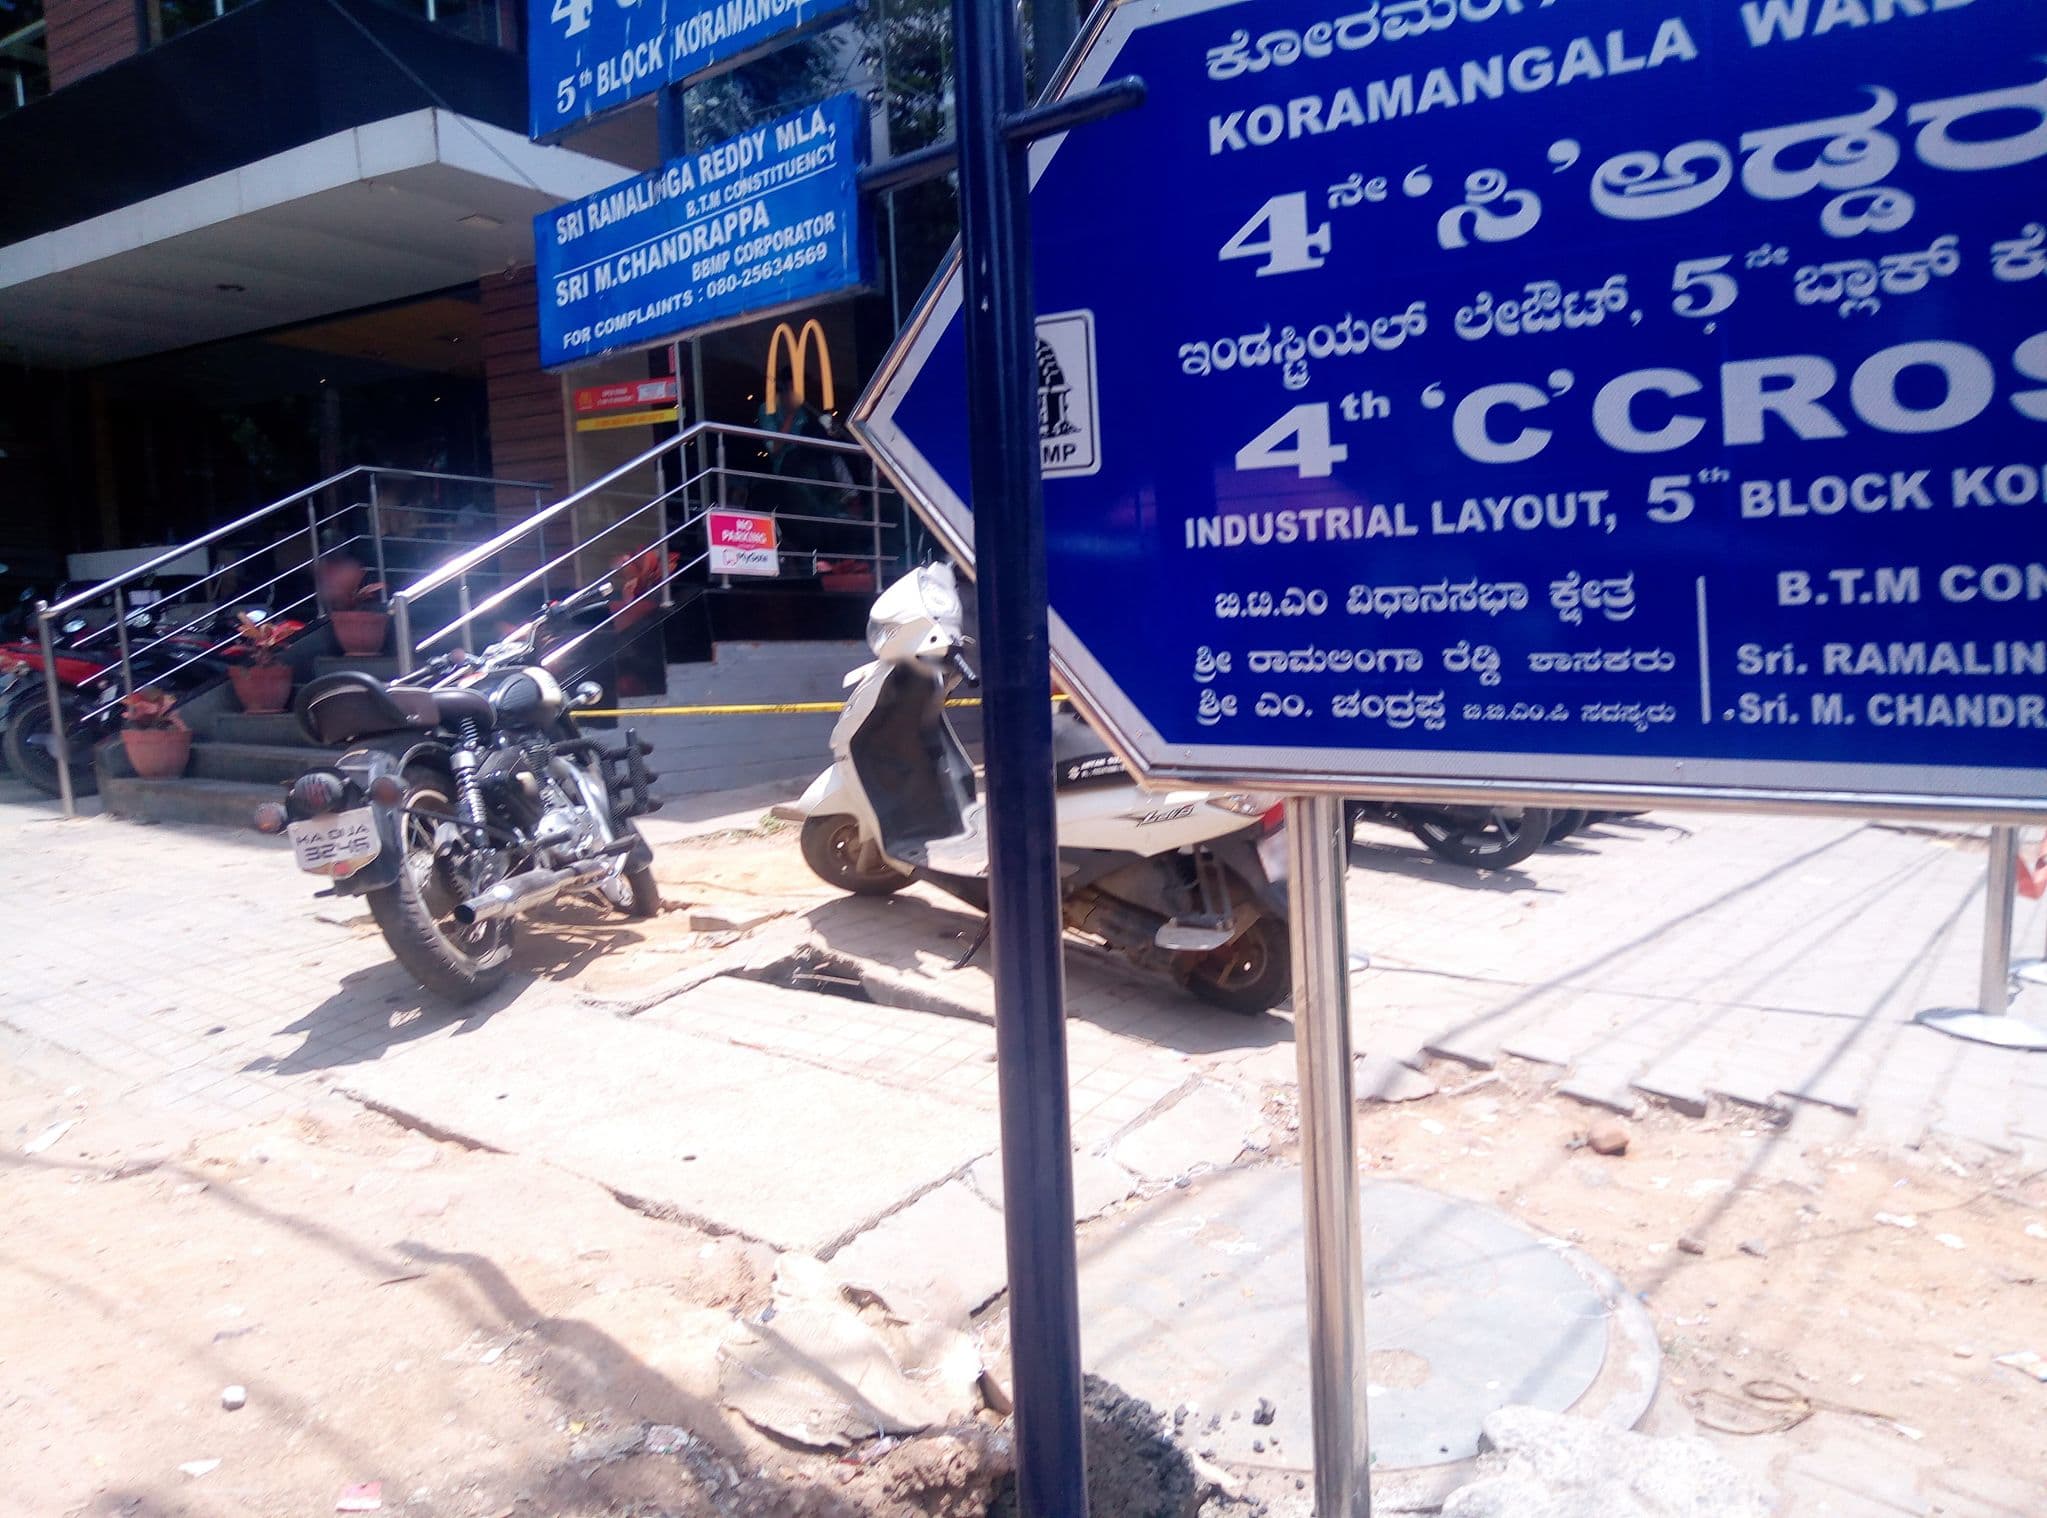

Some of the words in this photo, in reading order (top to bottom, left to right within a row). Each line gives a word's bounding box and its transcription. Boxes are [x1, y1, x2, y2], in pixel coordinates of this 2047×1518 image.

[597, 34, 665, 97] BLOCK
[1208, 17, 1698, 155] KORAMANGALA
[1740, 0, 1978, 47] WA
[556, 208, 584, 245] SRI
[587, 162, 695, 233] RAMALINGA
[699, 128, 766, 187] REDDY
[775, 108, 836, 153] MLA,
[724, 140, 837, 205] CONSTITUENCY
[555, 273, 589, 307] SRI
[594, 199, 770, 295] M.CHANDRAPPA
[691, 249, 731, 283] BBMP
[733, 210, 836, 267] CORPORATOR
[563, 326, 591, 350] FOR
[594, 288, 693, 339] COMPLAINTS
[706, 241, 828, 299] 080-25634569
[1185, 502, 1419, 549] INDUSTRIAL
[1431, 490, 1617, 536] LAYOUT,
[1740, 470, 1933, 518] BLOCK
[1952, 464, 2047, 508] KO
[1777, 566, 1920, 606] B.T.M
[1736, 643, 1809, 675] Sri.
[1823, 641, 2047, 675] RAMALIN
[1811, 693, 1856, 725] M.
[1866, 693, 2047, 728] CHANDR
